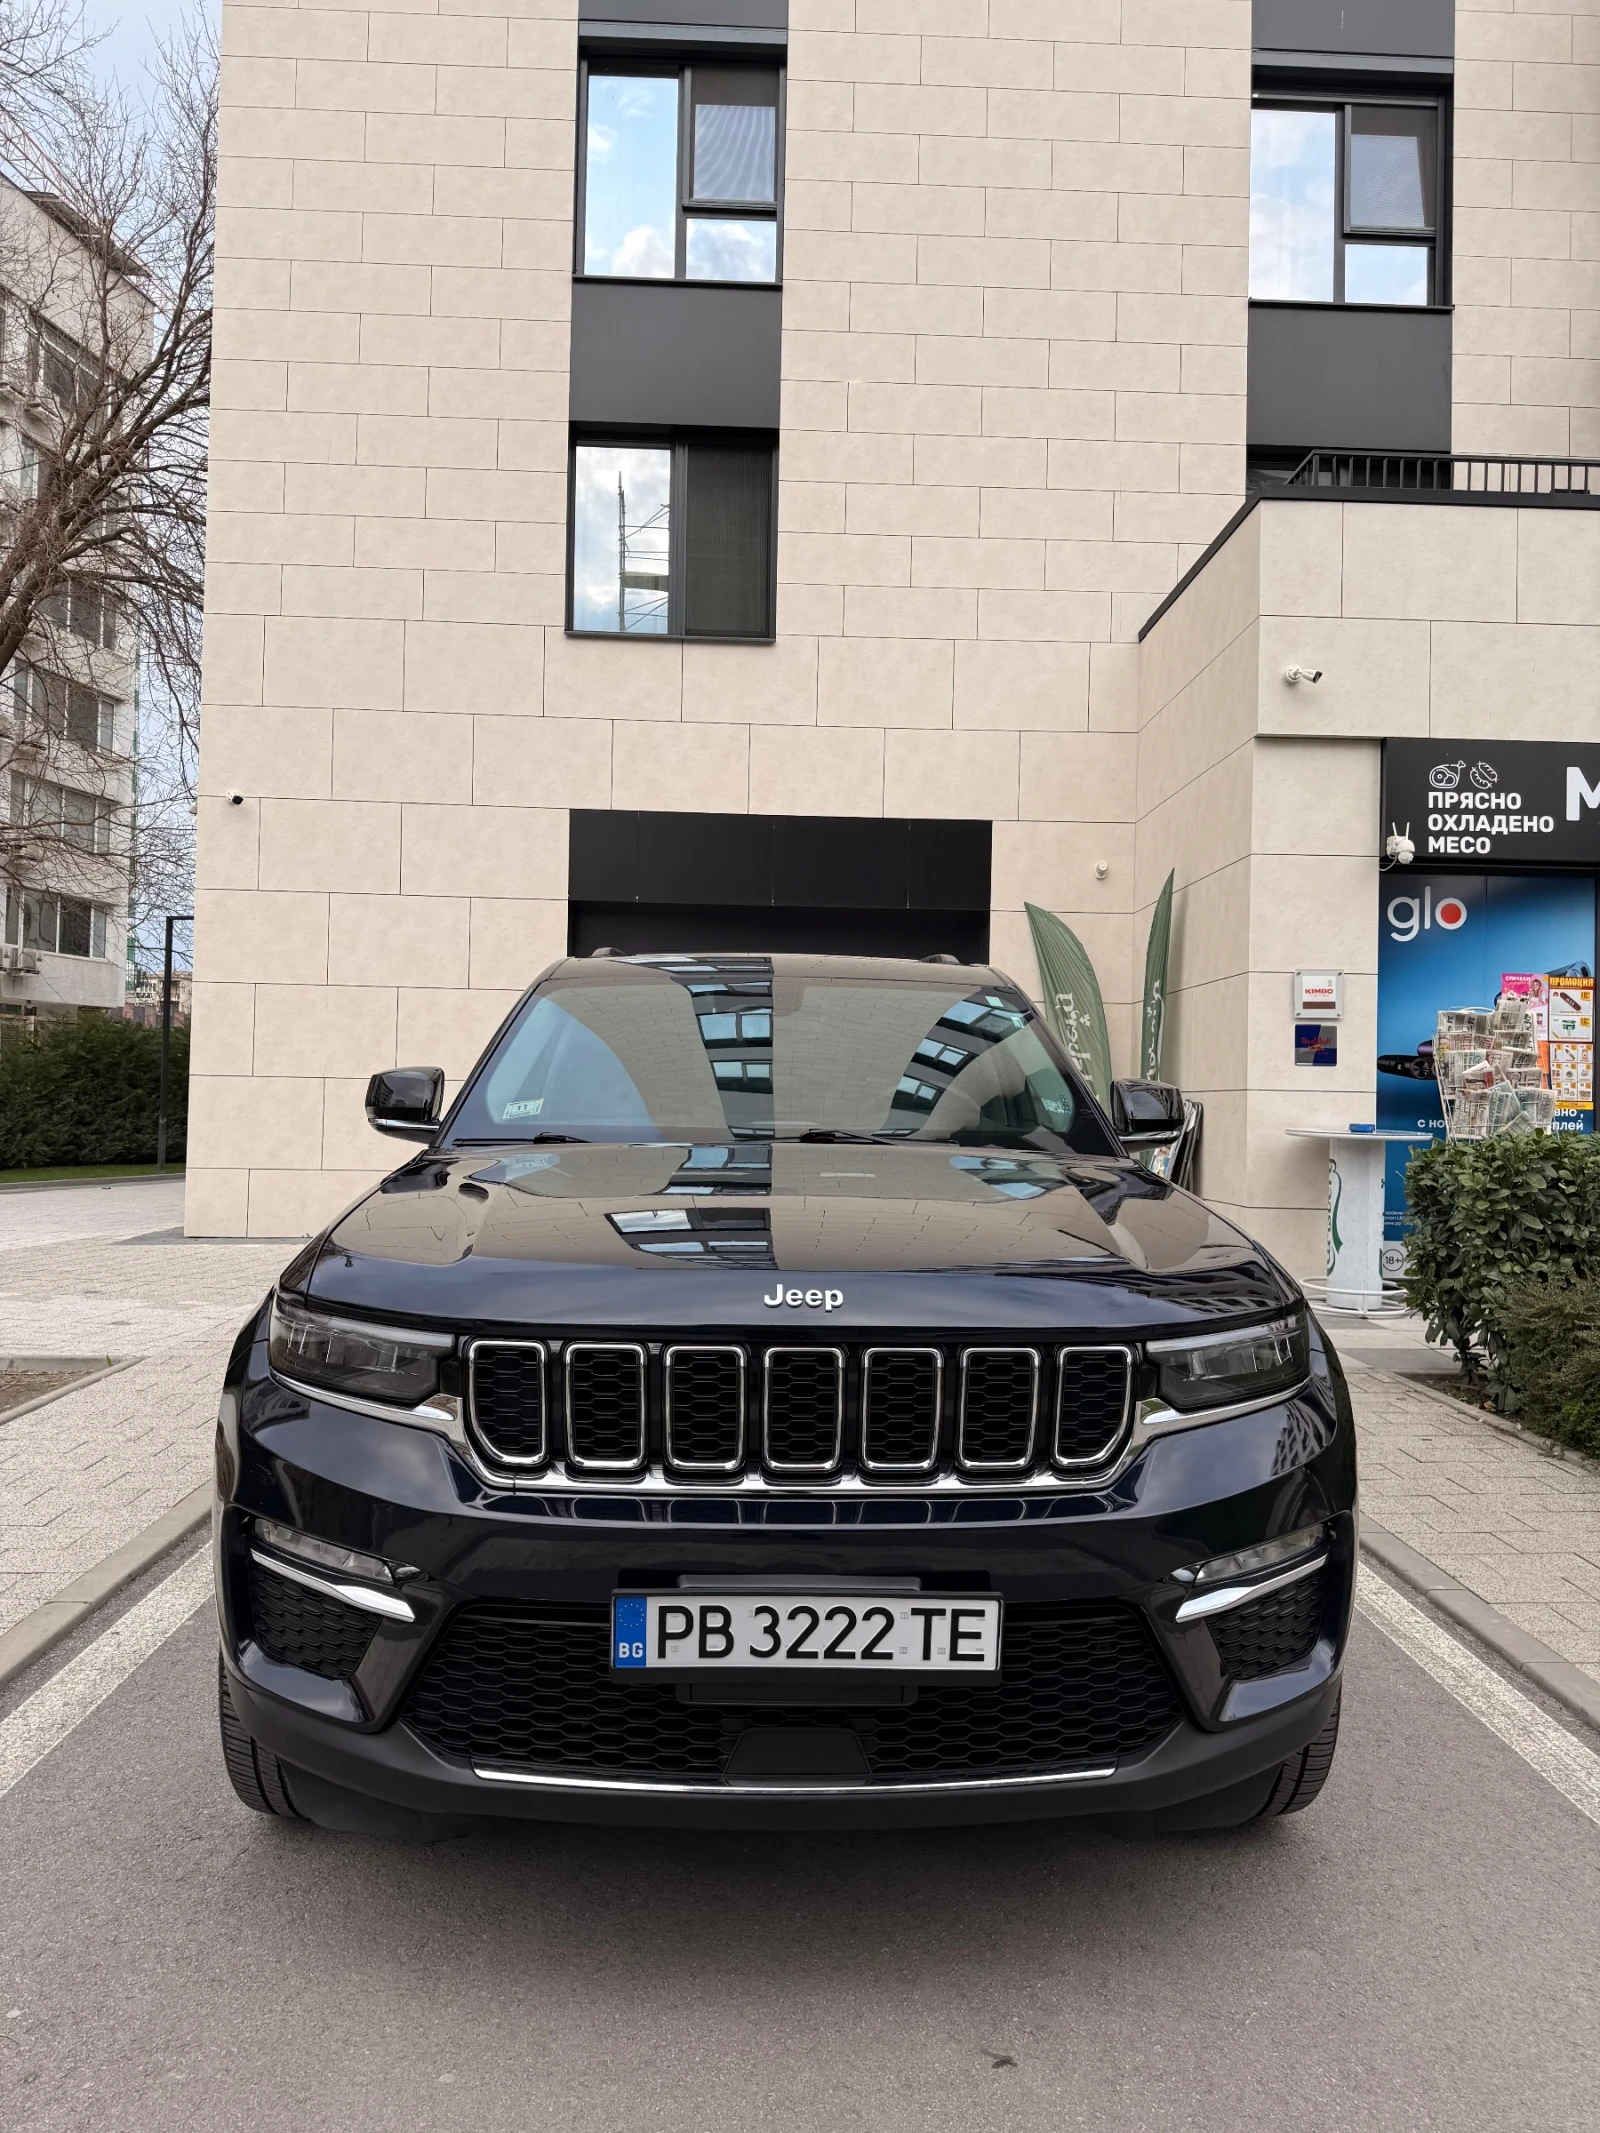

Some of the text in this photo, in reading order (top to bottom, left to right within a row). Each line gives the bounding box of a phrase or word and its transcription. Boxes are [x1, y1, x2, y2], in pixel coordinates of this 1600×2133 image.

[1428, 791, 1522, 810] ПРЯСНО
[1428, 814, 1554, 835] ОХЛАДЕНО
[1428, 836, 1491, 854] МЕСО
[1387, 886, 1467, 942] glo
[1549, 977, 1594, 987] ПРОМОЦИЯ
[1429, 1119, 1446, 1128] но
[1552, 1119, 1584, 1131] плей
[1385, 1256, 1400, 1265] 18+
[763, 1283, 844, 1312] Jeep
[657, 1604, 986, 1662] PB 3222 TE
[618, 1642, 643, 1659] BG
